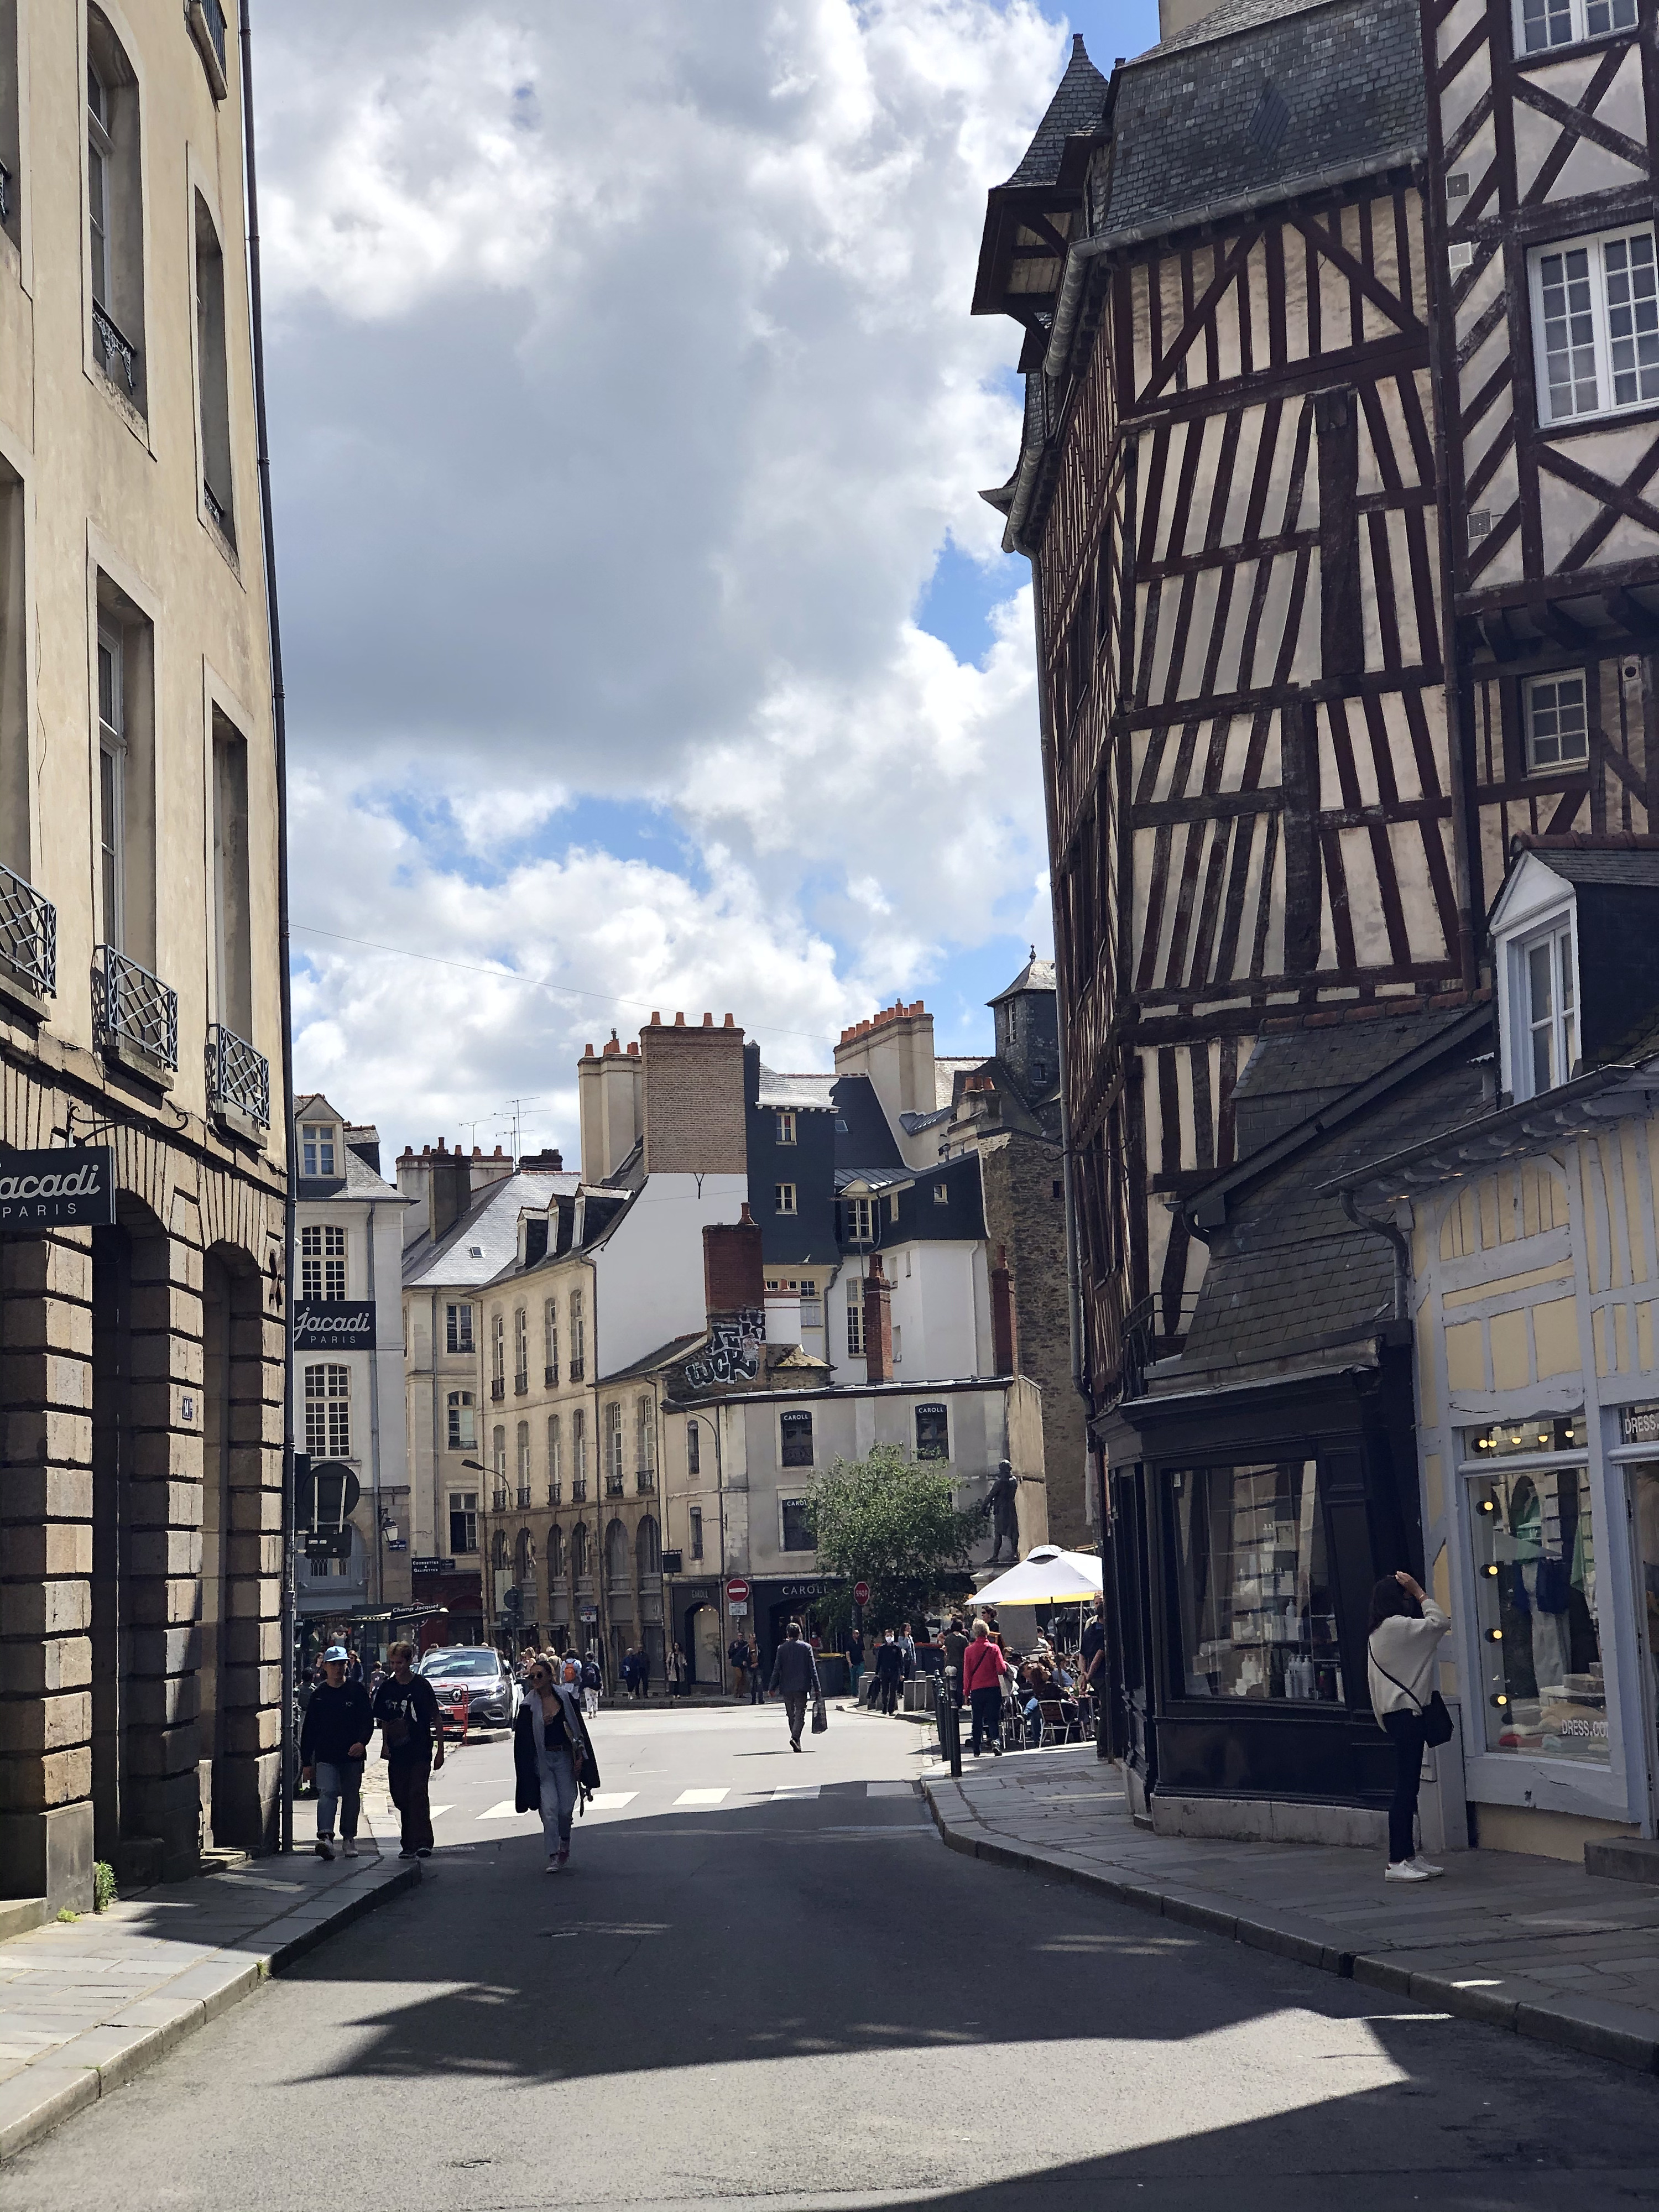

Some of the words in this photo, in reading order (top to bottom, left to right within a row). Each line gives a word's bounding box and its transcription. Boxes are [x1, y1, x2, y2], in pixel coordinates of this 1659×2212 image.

[0, 1164, 101, 1199] acadi
[3, 1203, 76, 1218] PARIS
[295, 1307, 371, 1342] jacadi
[692, 1589, 708, 1598] CAROLL
[782, 1585, 830, 1595] CAROLL
